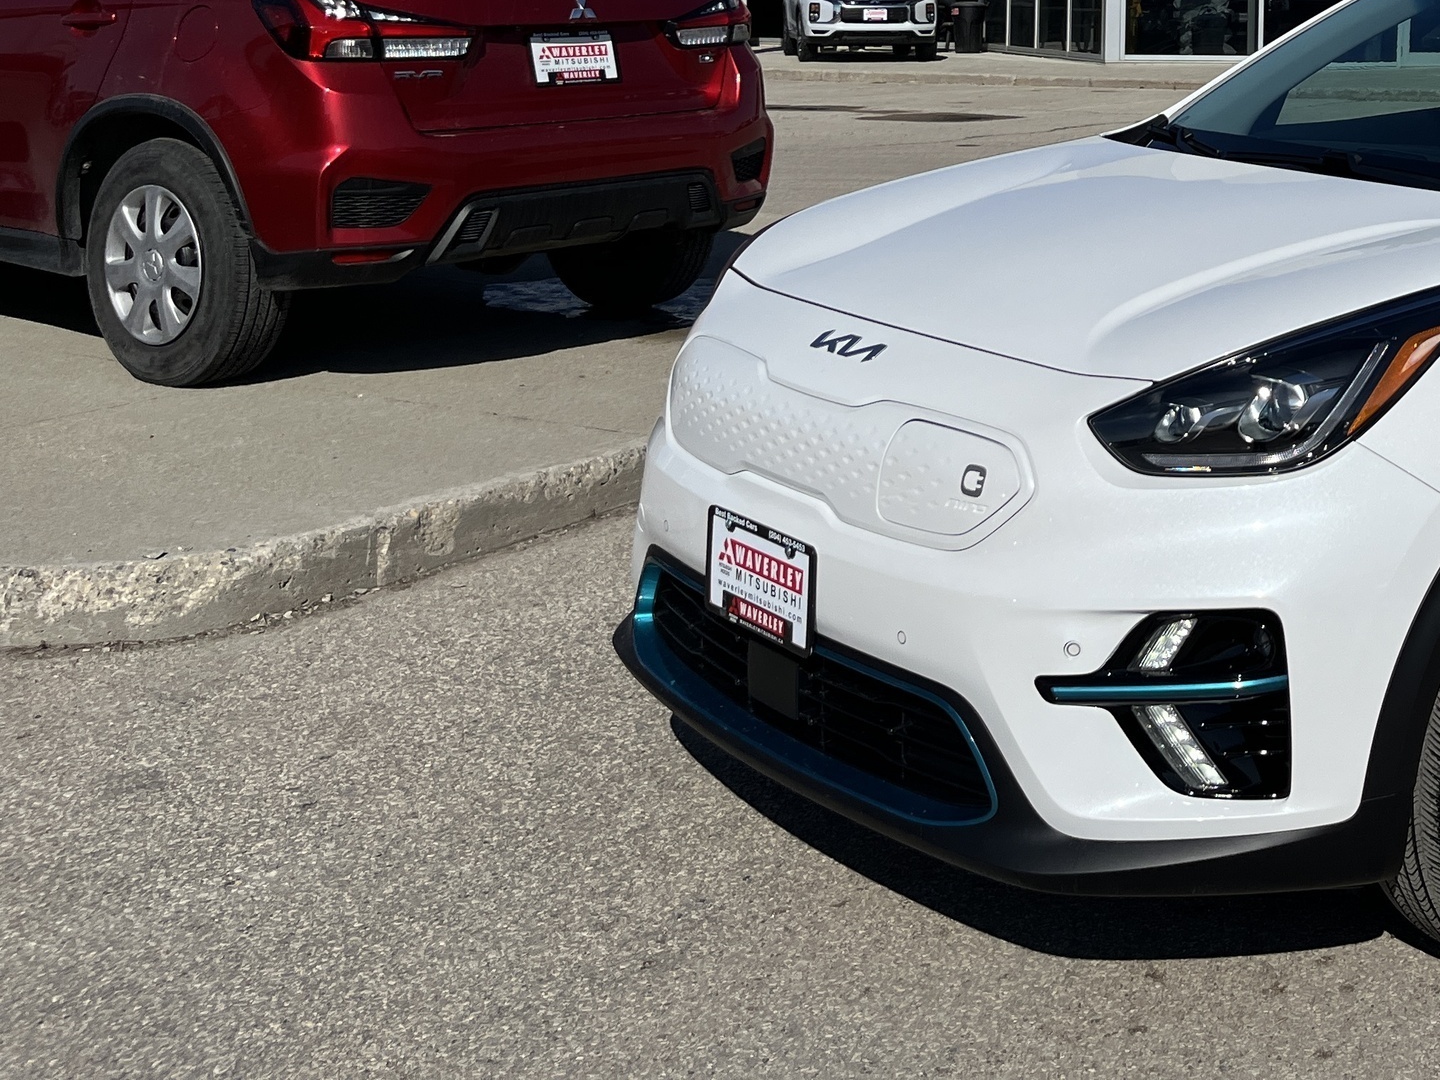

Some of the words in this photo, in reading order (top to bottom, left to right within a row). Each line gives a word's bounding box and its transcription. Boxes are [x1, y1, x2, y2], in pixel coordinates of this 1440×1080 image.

[551, 45, 606, 57] WAVERLEY
[555, 57, 609, 65] MITSUBISHI
[563, 70, 600, 79] WAVERLEY
[810, 329, 888, 363] KIA
[736, 543, 803, 591] WAVERLEY
[718, 578, 802, 624] waverleymitsubishi.com
[735, 568, 802, 610] MITSUBISHI
[740, 601, 784, 634] WAVERLEY
